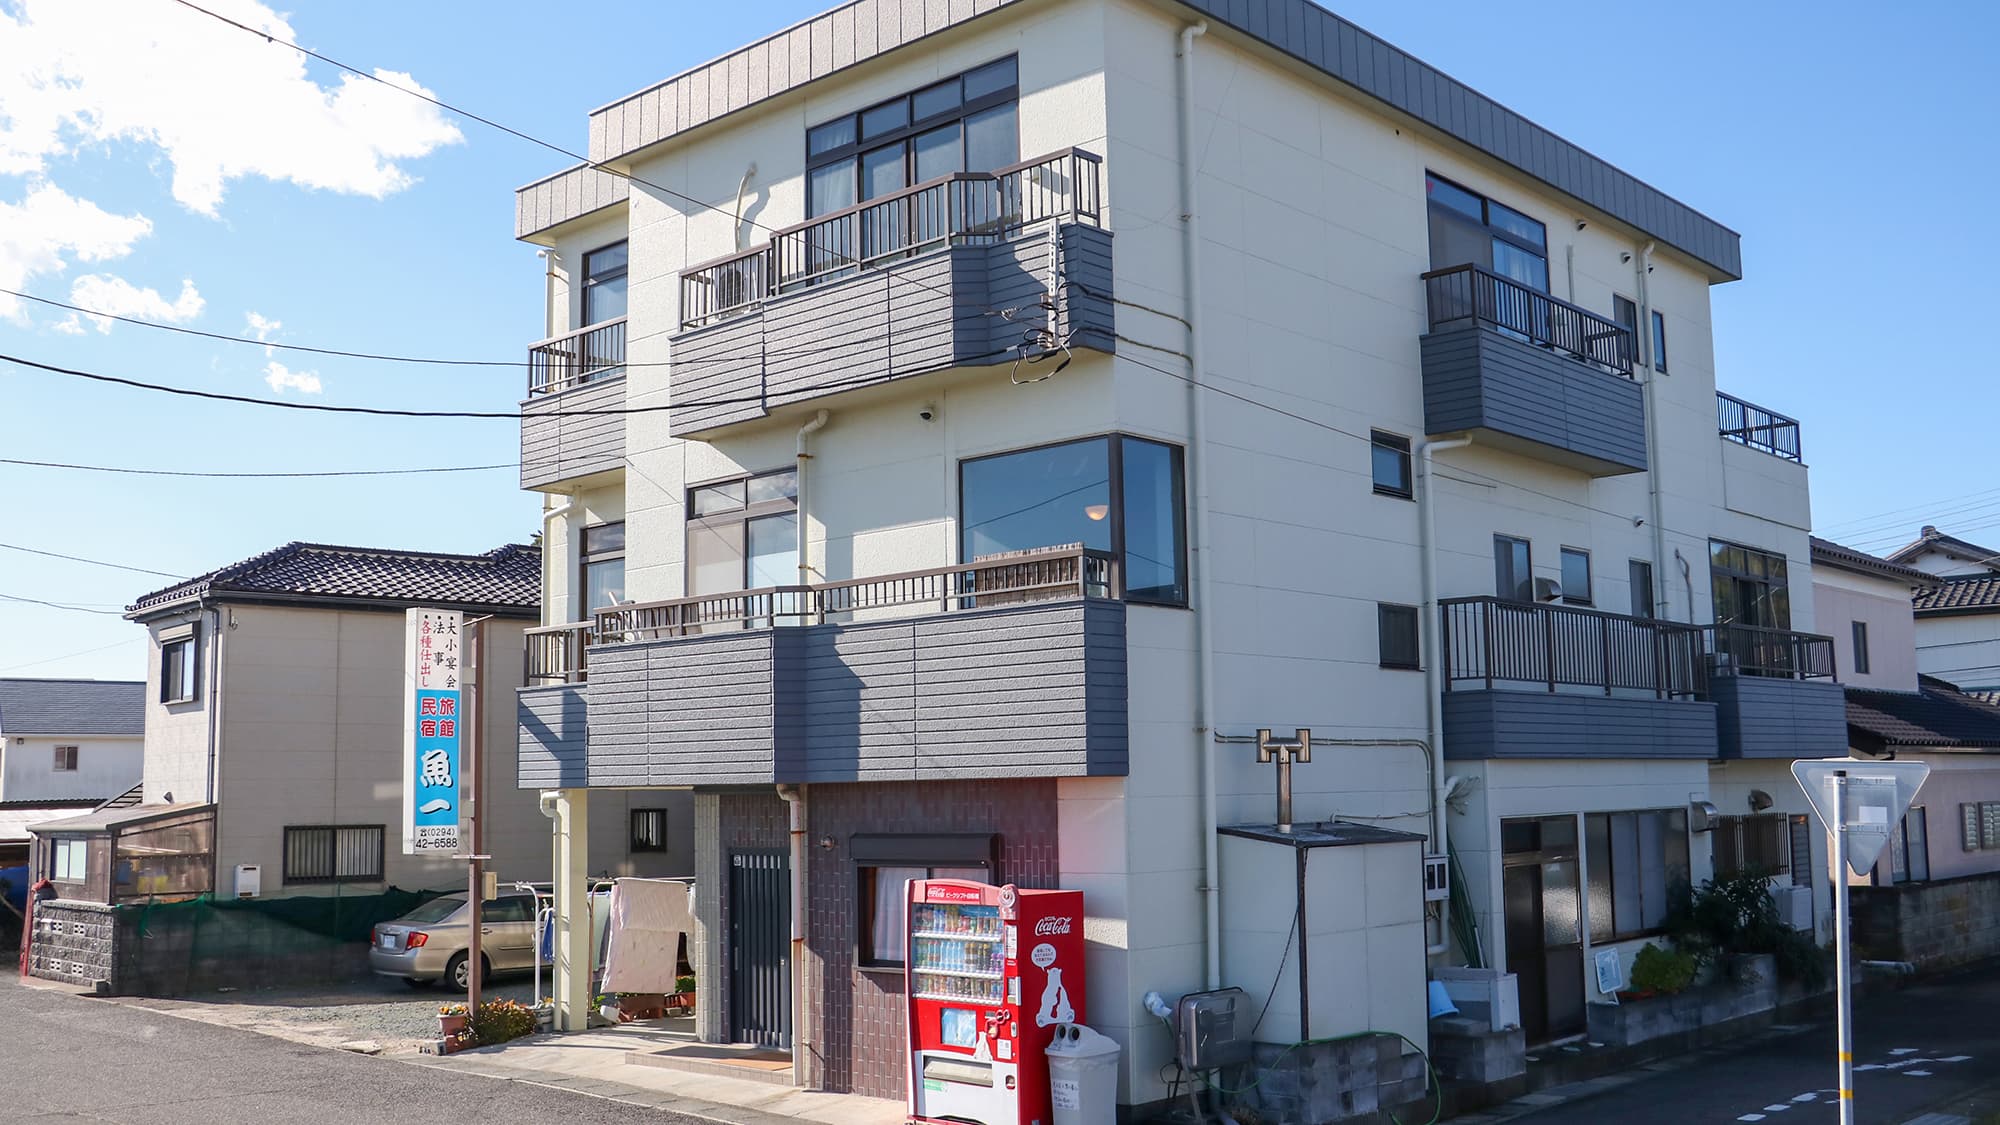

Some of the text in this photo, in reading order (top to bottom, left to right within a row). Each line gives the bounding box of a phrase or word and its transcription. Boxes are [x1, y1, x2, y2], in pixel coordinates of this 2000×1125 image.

[420, 620, 432, 687] 各種仕出し
[433, 621, 445, 666] 法事
[445, 621, 457, 688] 大小宴会
[421, 698, 437, 737] 民宿
[439, 698, 455, 737] 旅館
[419, 748, 453, 815] 魚一
[416, 838, 458, 849] 42-6588
